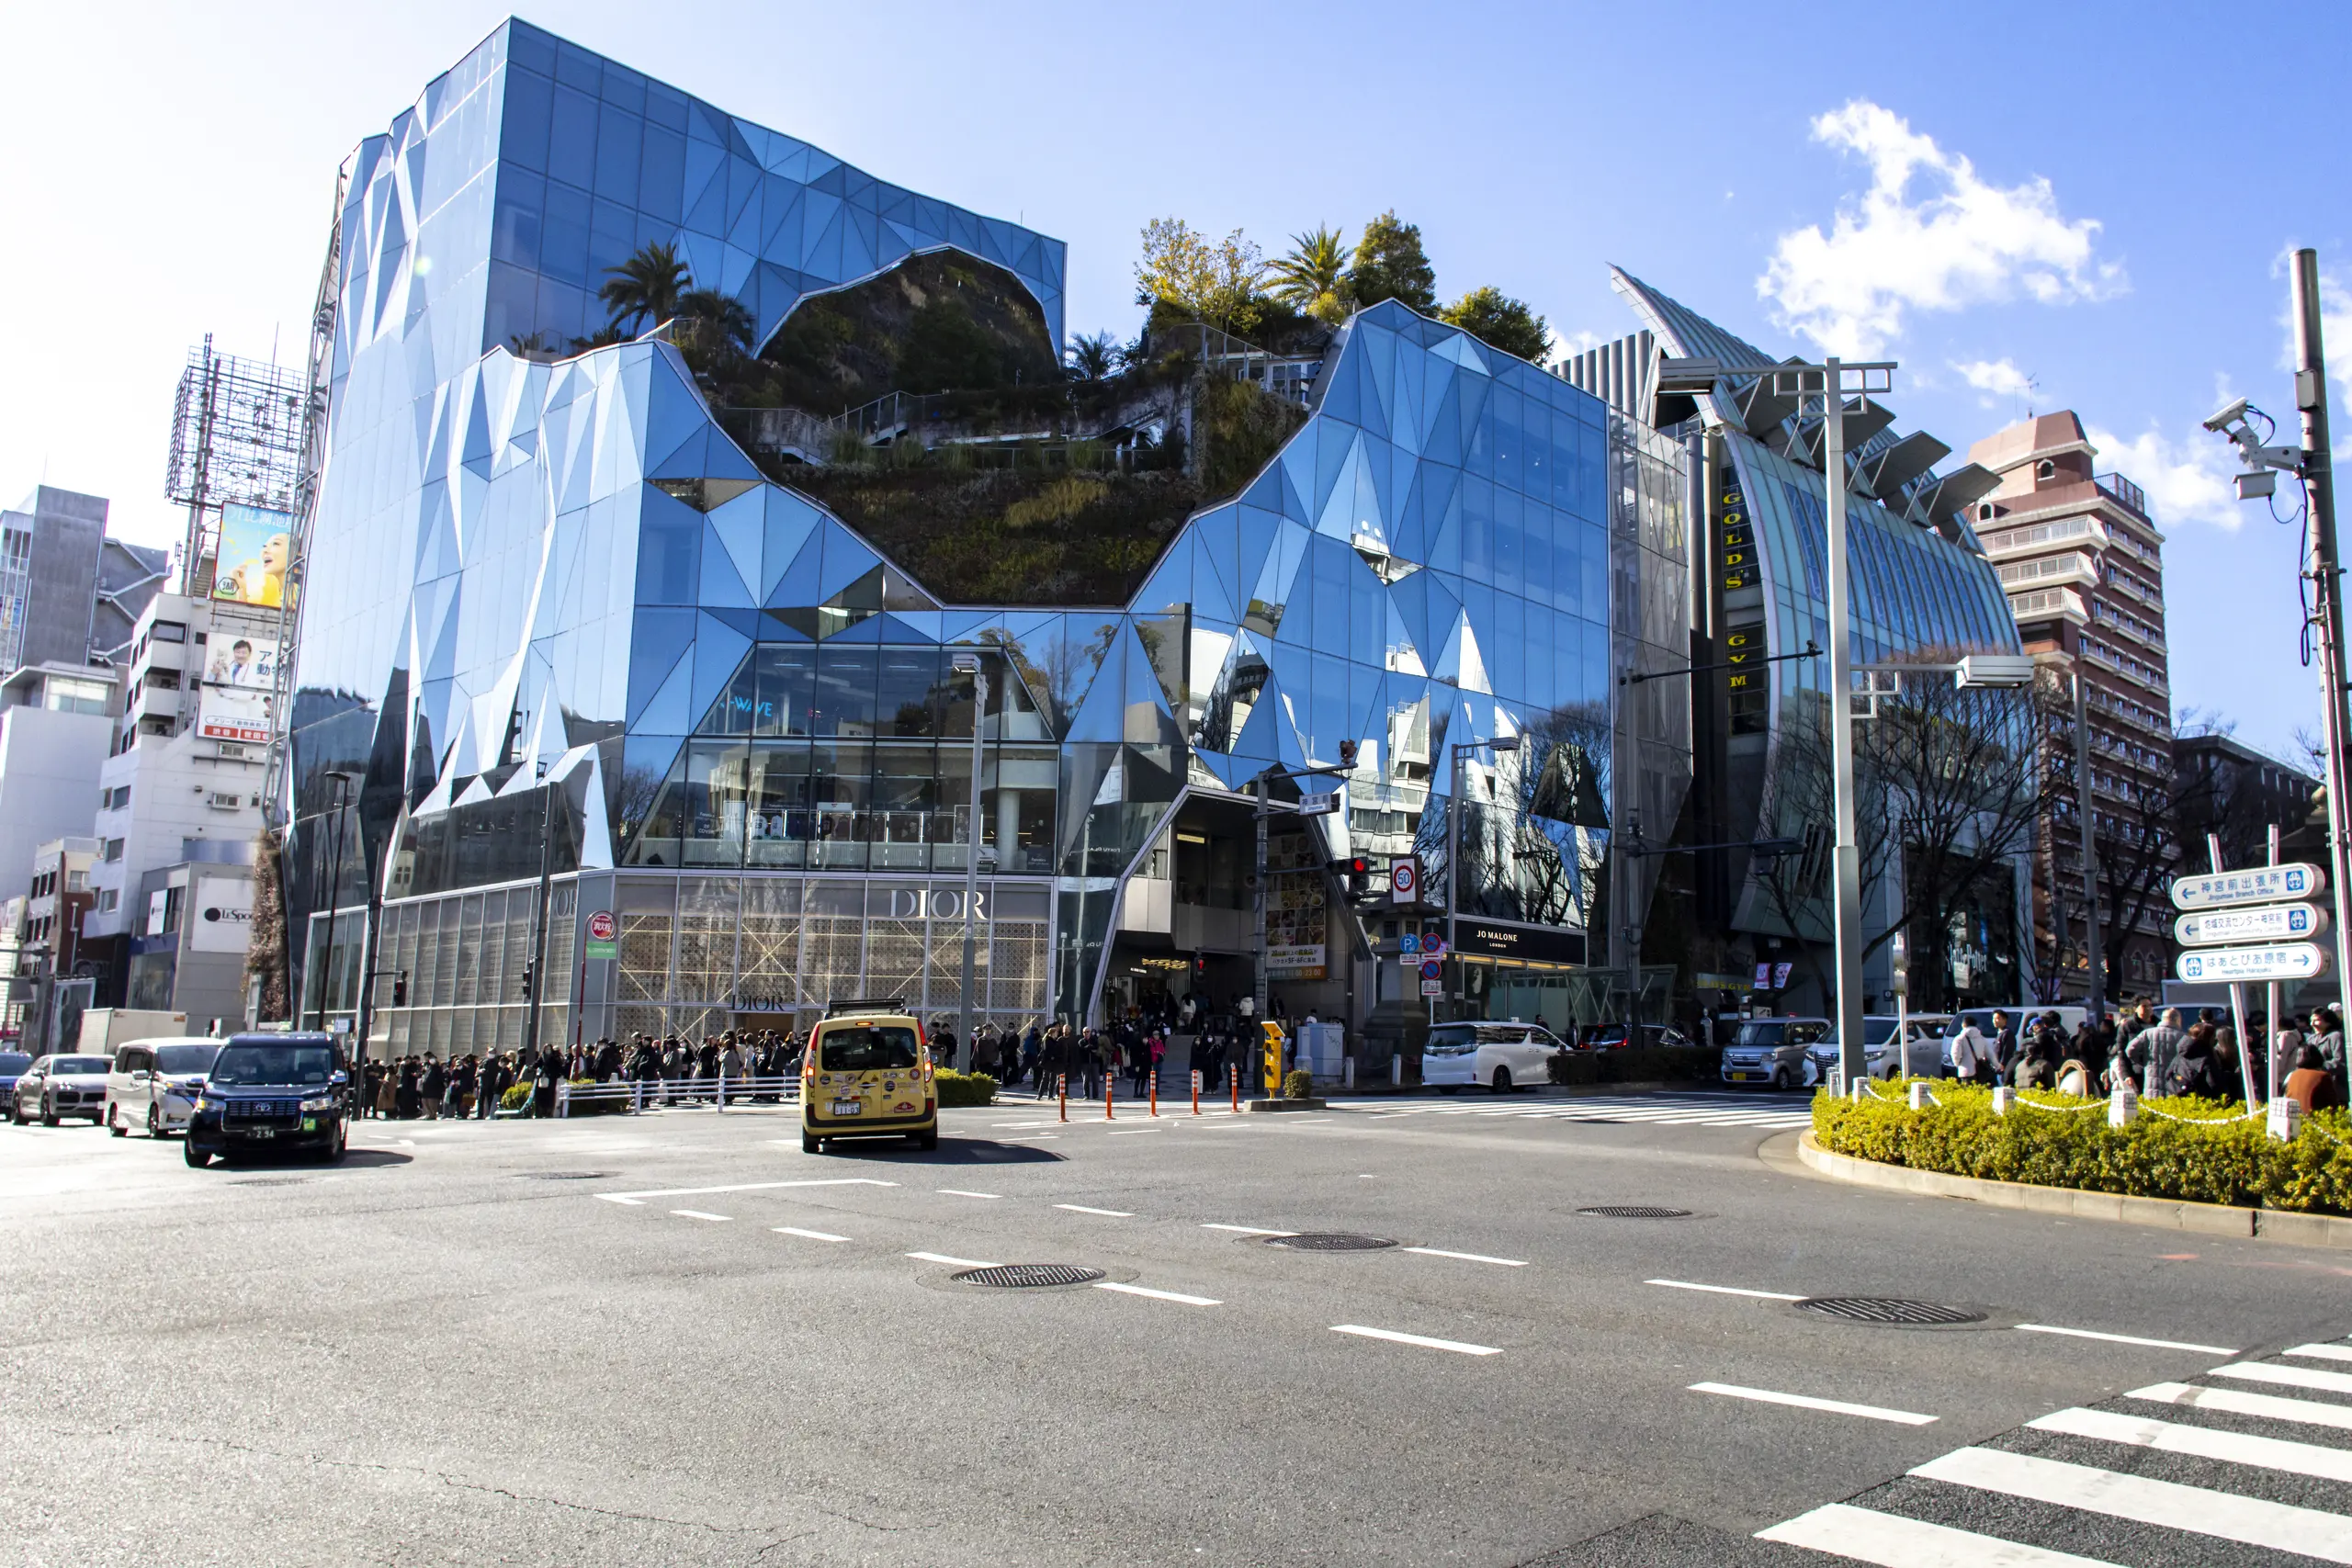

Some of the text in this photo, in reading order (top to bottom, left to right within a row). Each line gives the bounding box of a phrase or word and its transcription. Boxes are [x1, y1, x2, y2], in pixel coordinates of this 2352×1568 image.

[1723, 492, 1743, 589] GOLD'S
[1302, 795, 1329, 806] 神宮前
[1397, 873, 1410, 885] 50
[2201, 873, 2280, 893] 神宮前出張所
[2208, 893, 2233, 901] Jingumae
[2235, 890, 2255, 898] Branch
[888, 889, 989, 920] DIOR
[594, 921, 612, 932] 消火栓
[2205, 913, 2283, 929] 地域交流センター神宮前
[1476, 930, 1518, 942] JO MALONE
[731, 994, 785, 1011] DIOR
